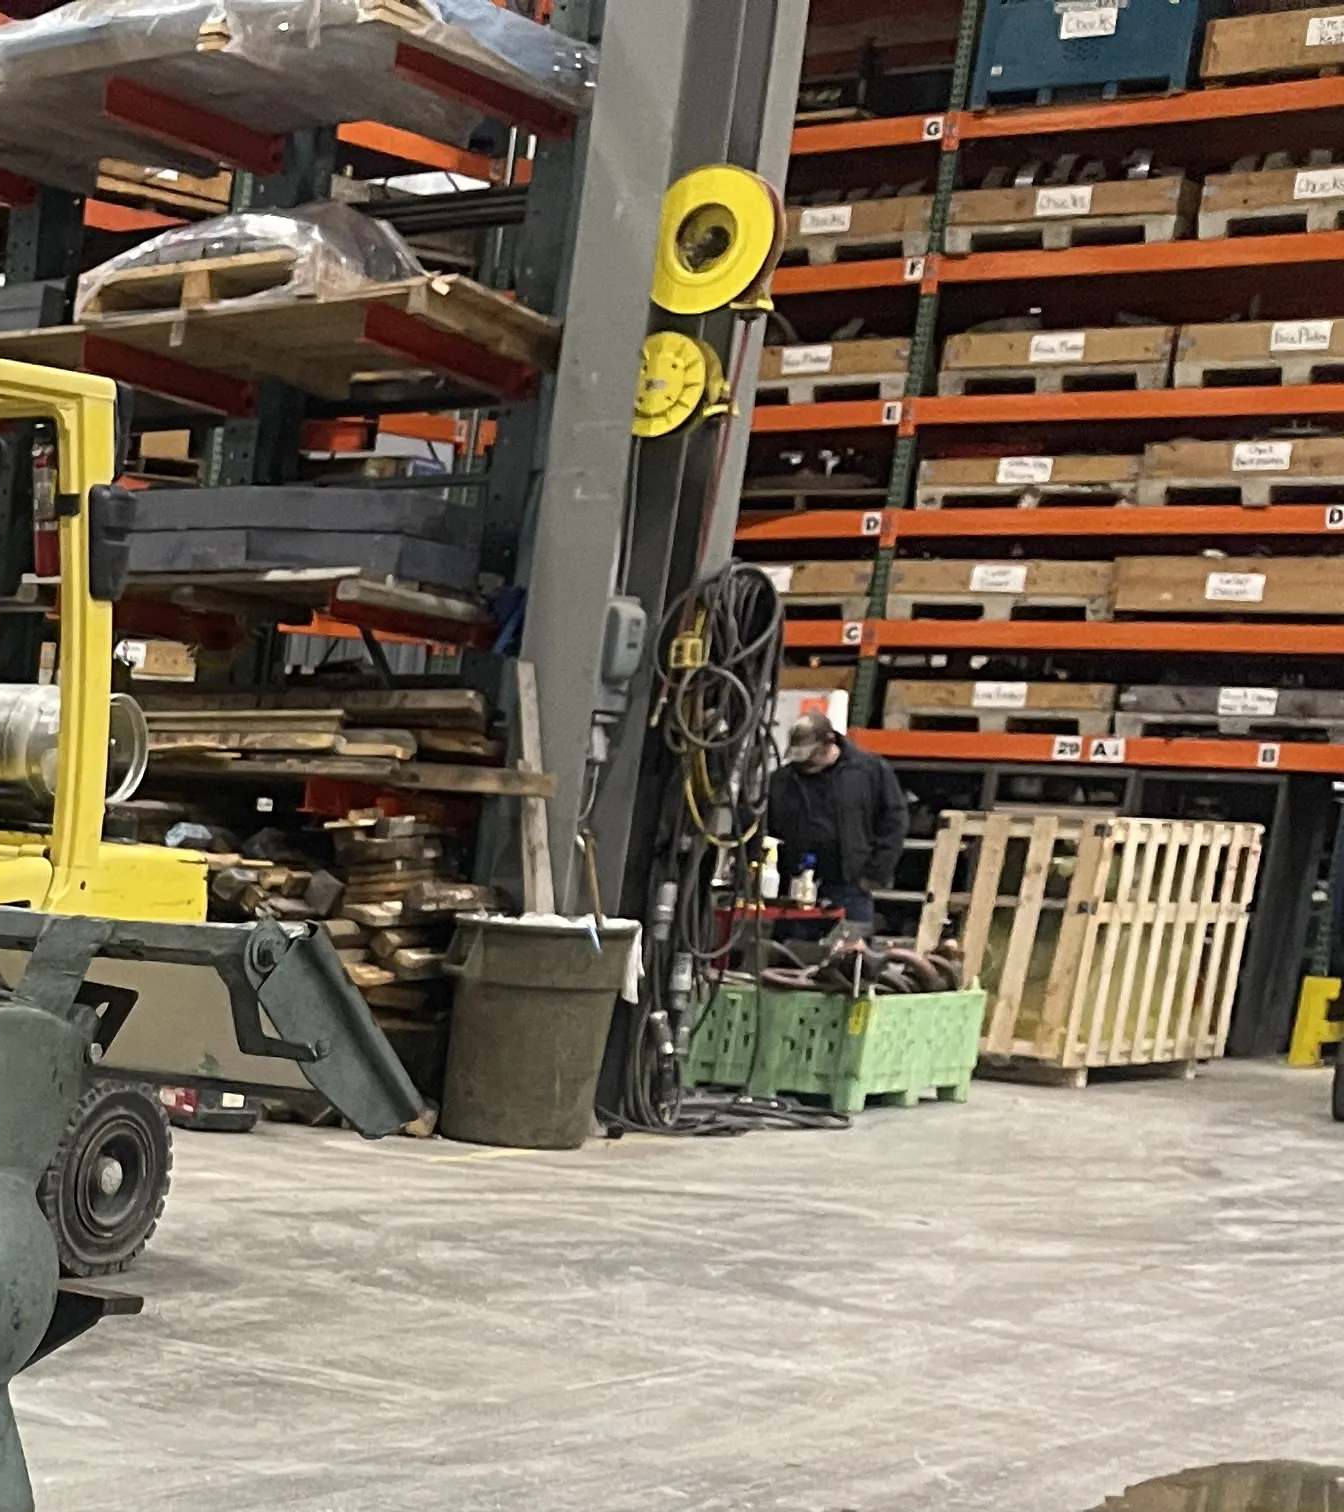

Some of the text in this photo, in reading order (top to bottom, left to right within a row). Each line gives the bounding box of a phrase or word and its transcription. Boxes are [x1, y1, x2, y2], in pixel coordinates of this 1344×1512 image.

[925, 120, 940, 136] G
[865, 516, 879, 531] D
[1329, 508, 1344, 524] D
[845, 625, 860, 642] C
[1092, 741, 1107, 757] A
